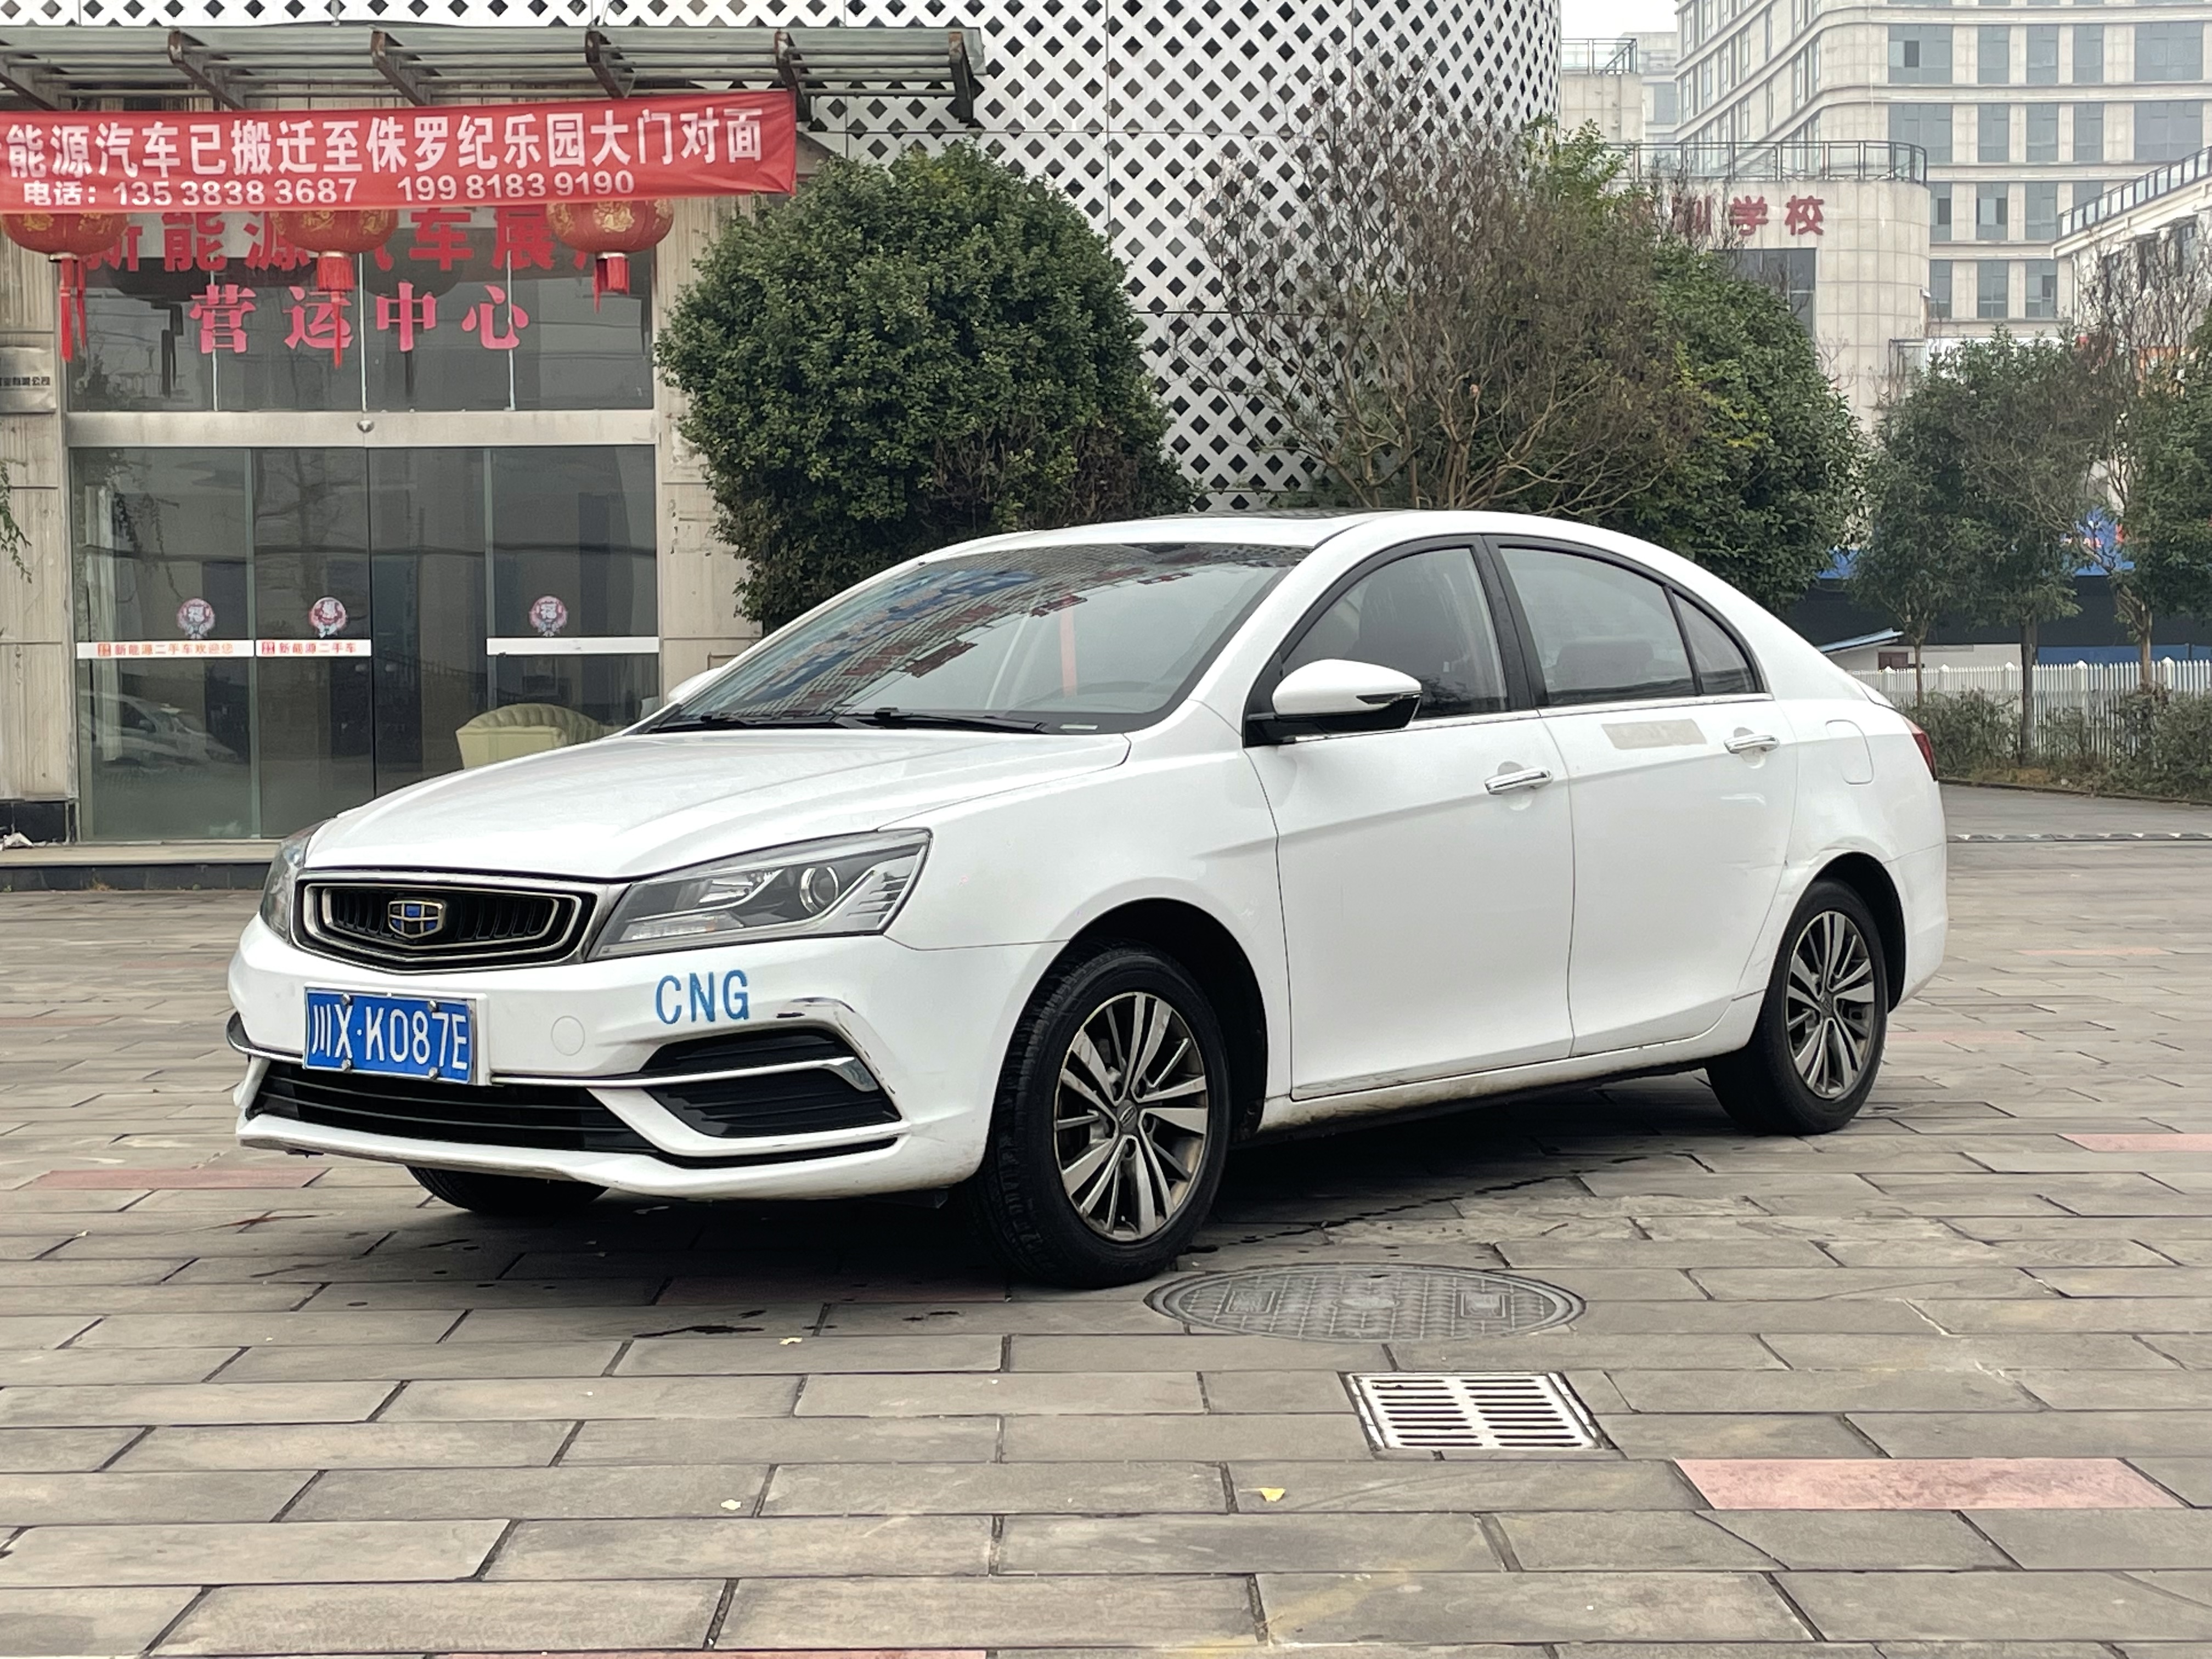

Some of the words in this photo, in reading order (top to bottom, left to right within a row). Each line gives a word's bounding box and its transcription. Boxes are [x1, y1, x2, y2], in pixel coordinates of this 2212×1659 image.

[0, 107, 763, 178] 能源汽车已搬迁至侏罗纪乐园大门对面
[112, 180, 171, 206] 135
[182, 179, 266, 205] 3838
[274, 178, 358, 204] 3687
[398, 175, 456, 202] 199
[466, 172, 546, 199] 8183
[554, 170, 634, 195] 9190
[189, 281, 529, 353] 营运中心
[656, 969, 749, 1025] CNG
[312, 1004, 467, 1070] 川X·K087E
